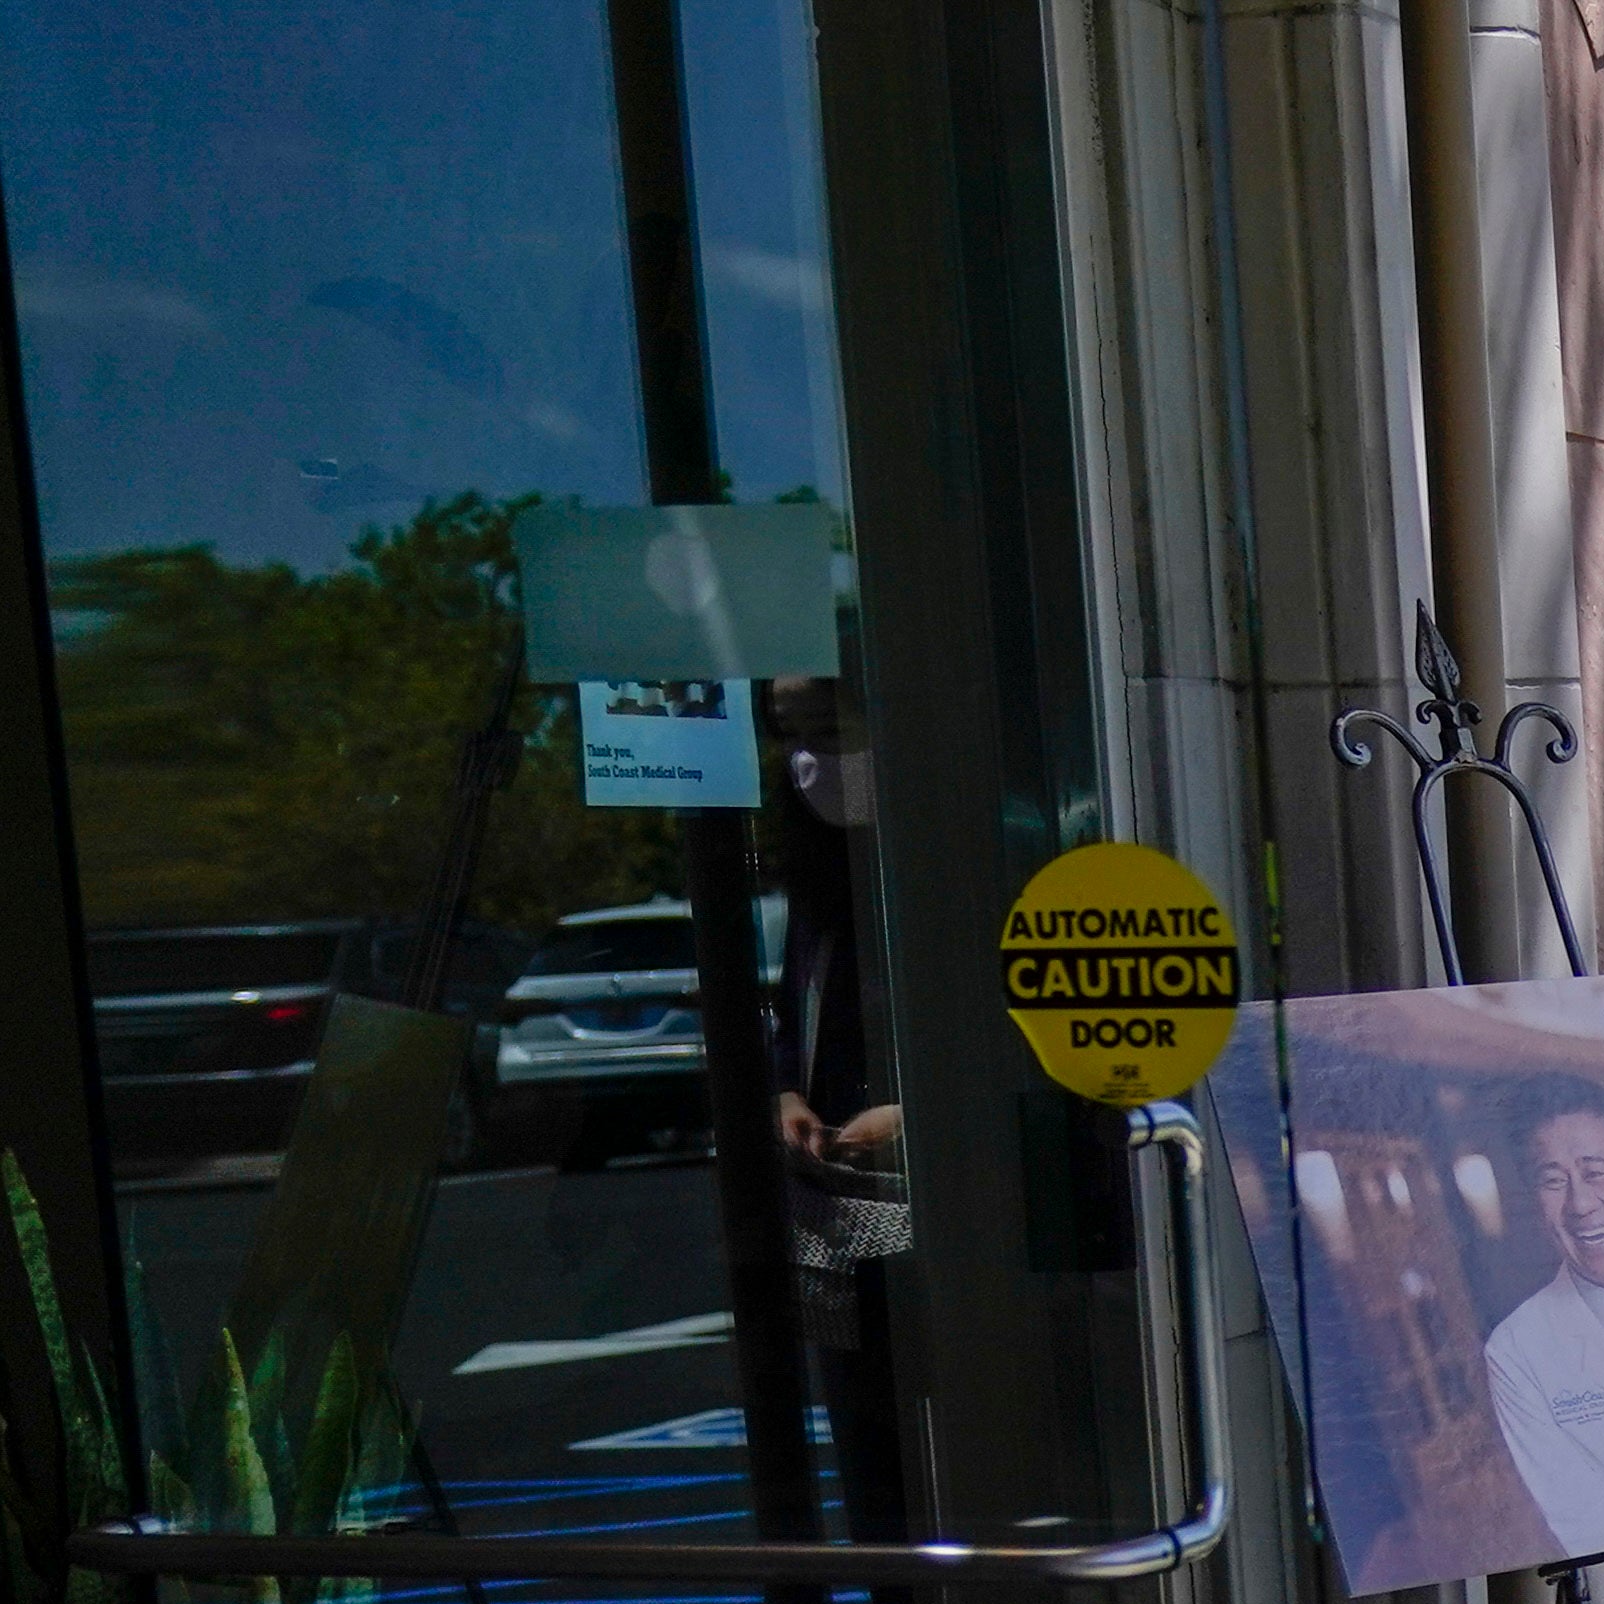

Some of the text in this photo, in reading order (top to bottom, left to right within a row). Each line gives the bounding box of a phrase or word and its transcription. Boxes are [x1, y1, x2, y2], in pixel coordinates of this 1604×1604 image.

[586, 743, 635, 761] Thank you,
[587, 764, 704, 782] South Coast Medical Group
[1008, 906, 1220, 940] AUTOMATIC
[1007, 955, 1233, 999] CAUTION
[1070, 1018, 1176, 1049] DOOR
